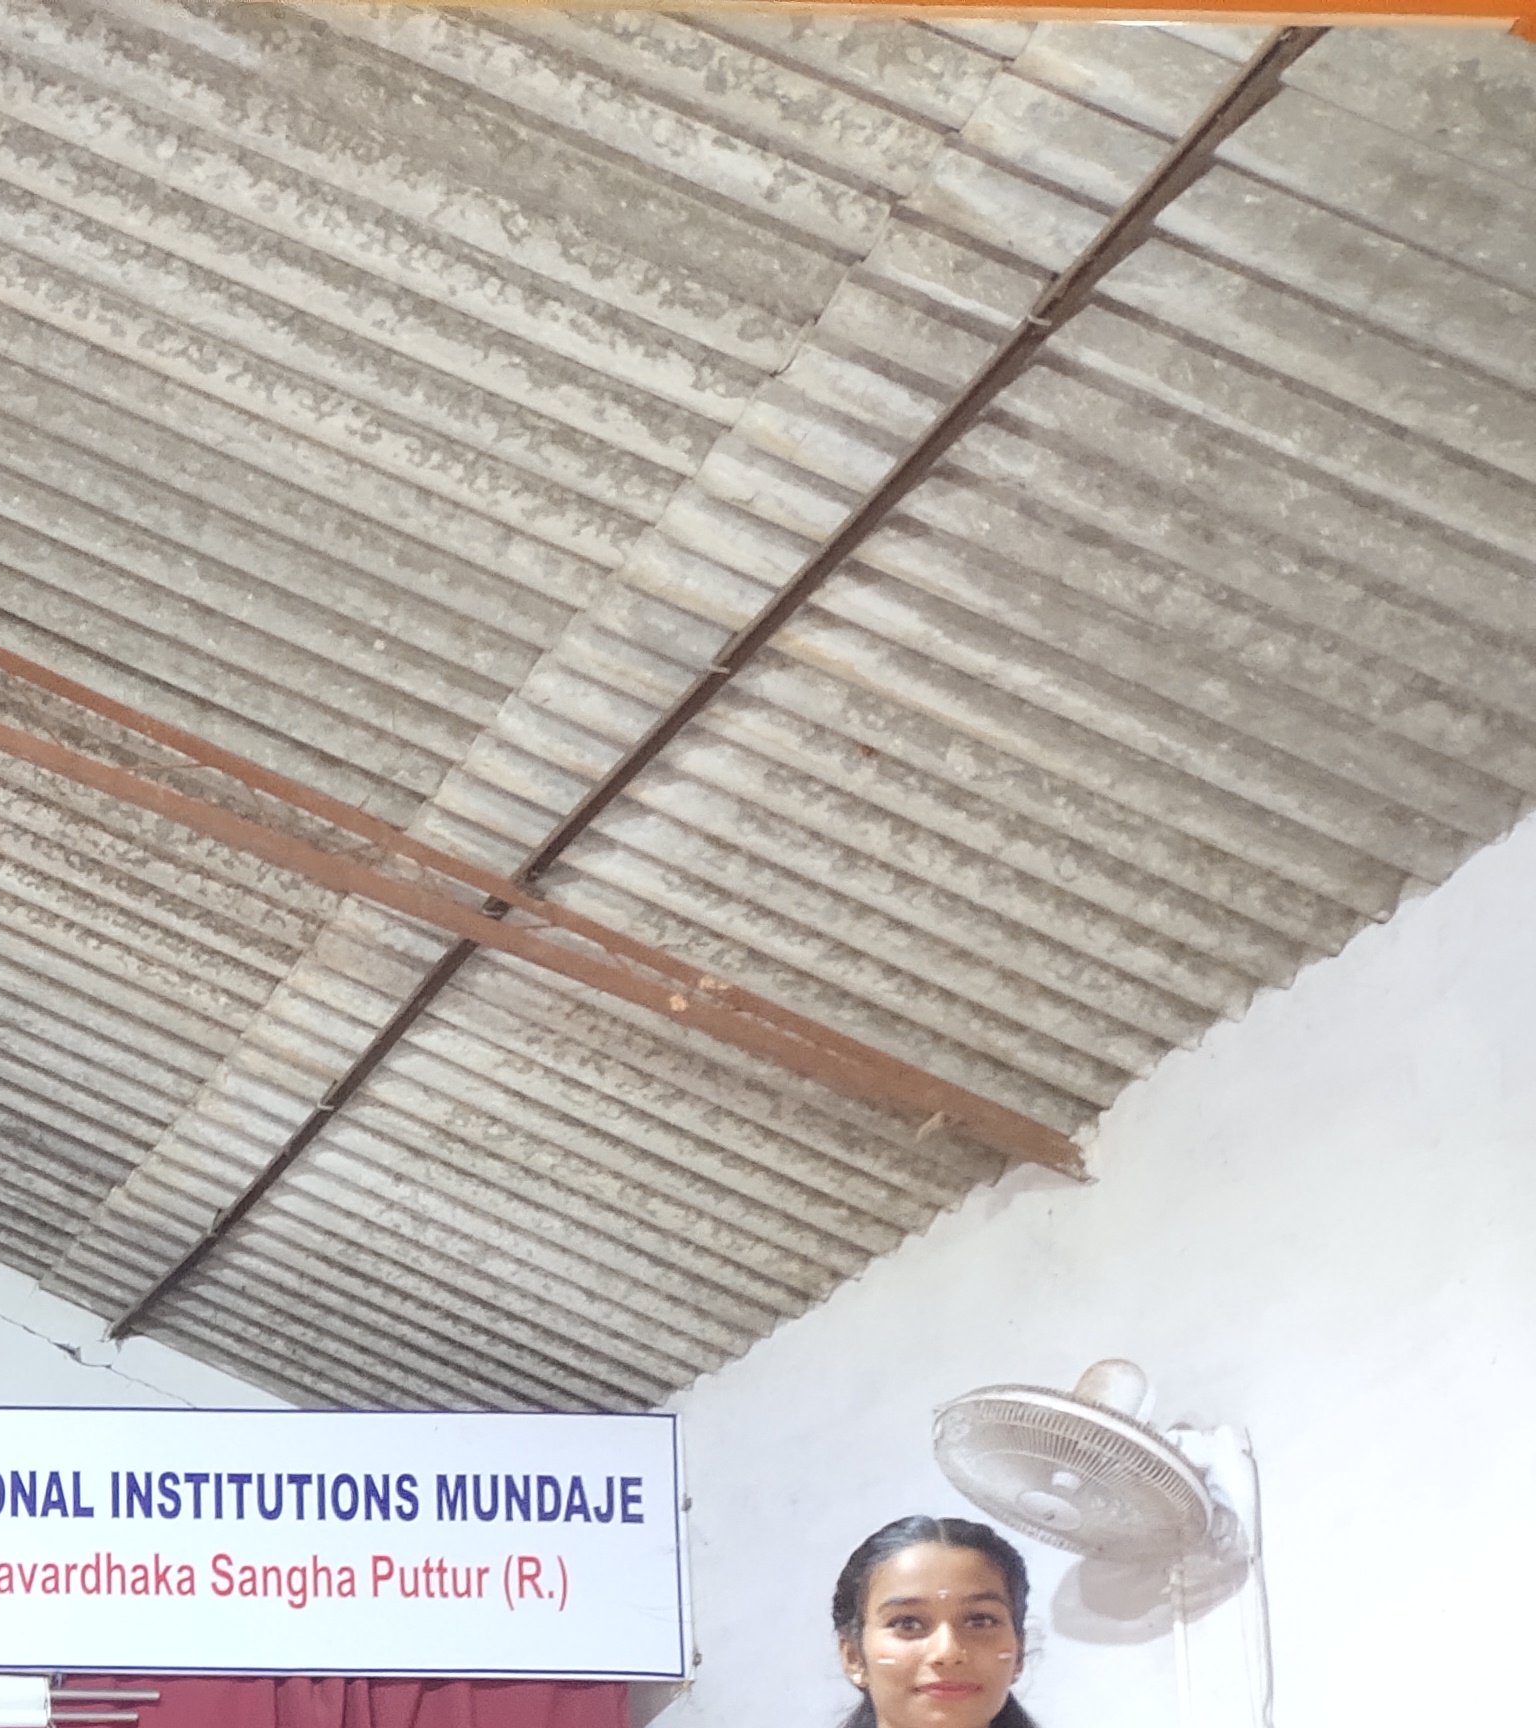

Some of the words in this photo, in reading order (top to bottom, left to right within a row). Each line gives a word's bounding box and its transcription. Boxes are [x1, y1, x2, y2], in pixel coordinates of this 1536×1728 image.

[110, 1471, 420, 1522] INSTITUTIONS
[435, 1474, 645, 1525] MUNDAJE
[210, 1552, 357, 1610] Sangha
[371, 1554, 491, 1599] Puttur
[503, 1554, 569, 1612] (R.)
